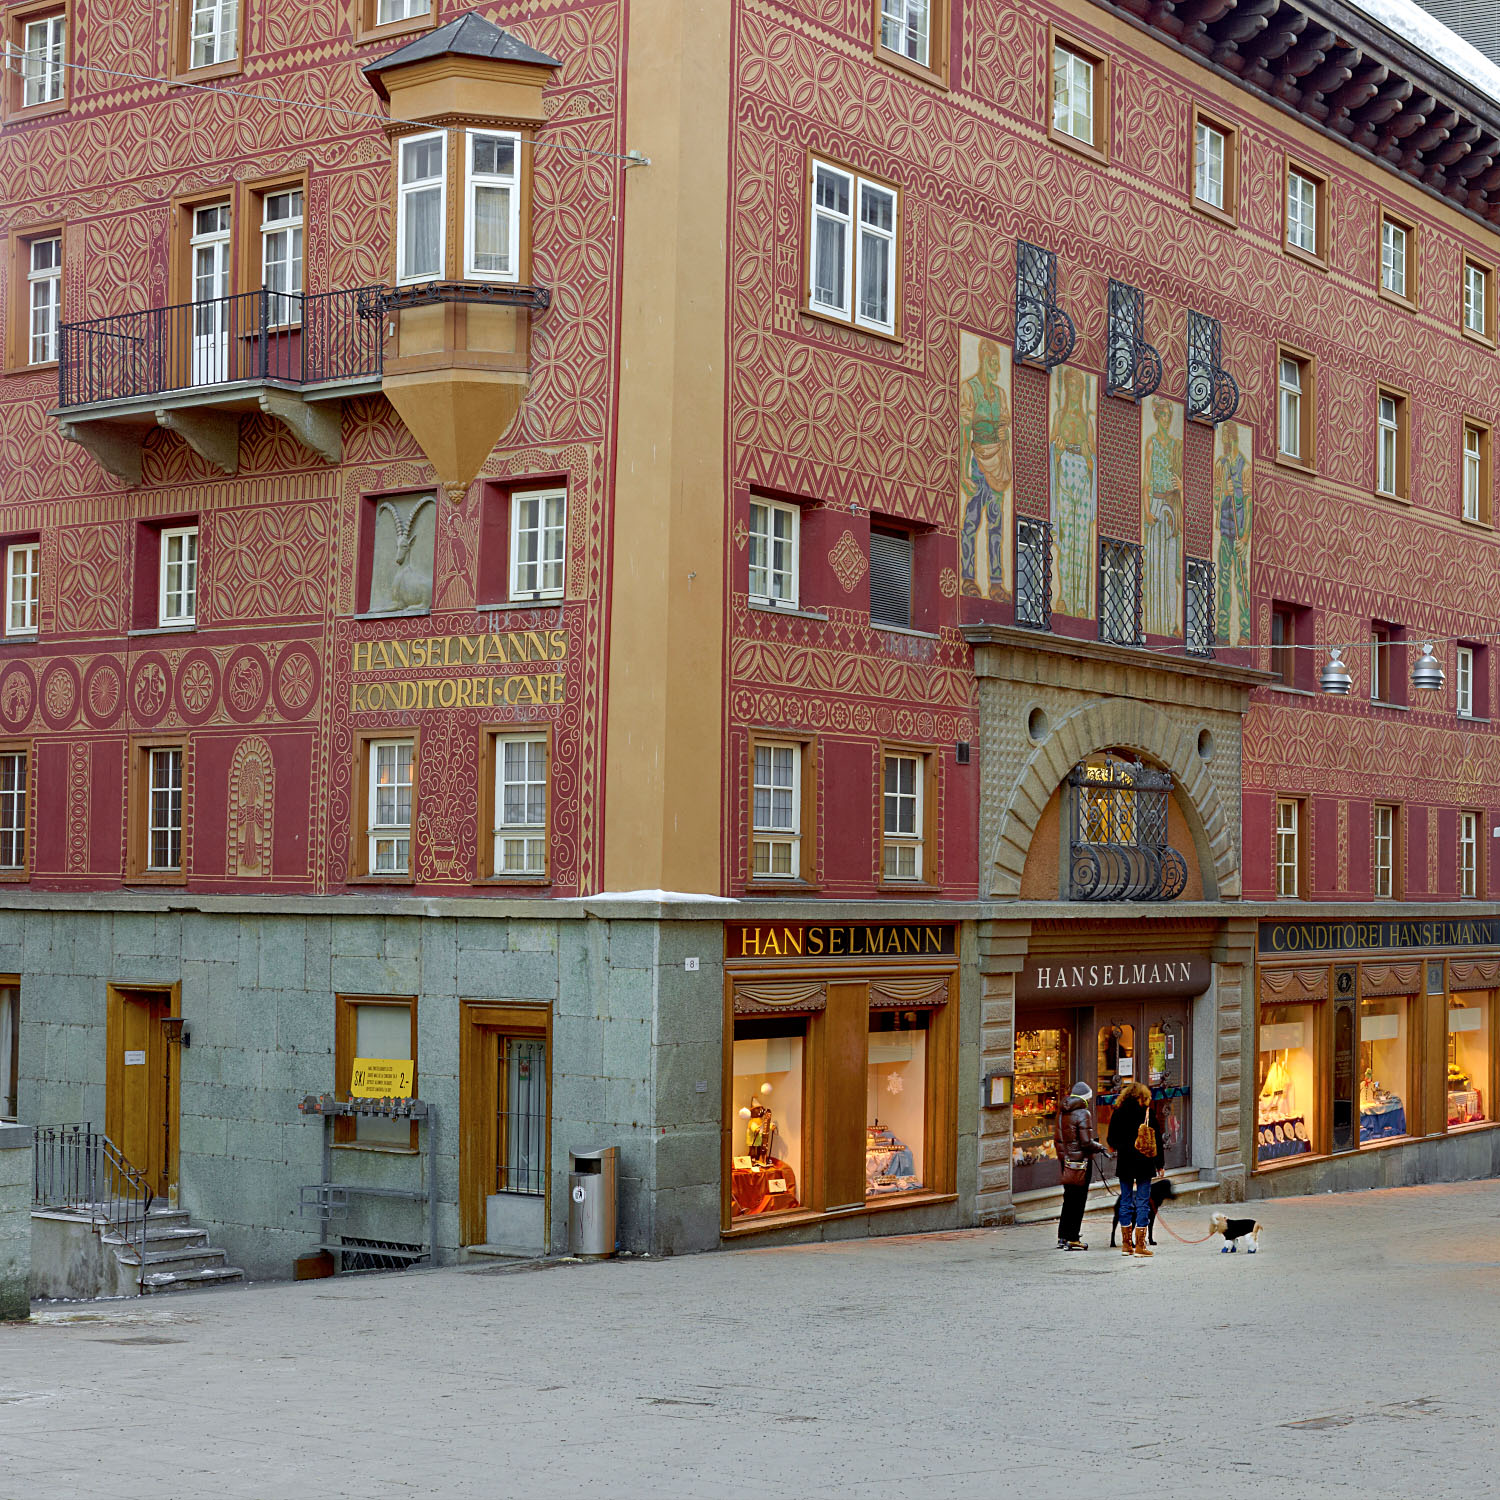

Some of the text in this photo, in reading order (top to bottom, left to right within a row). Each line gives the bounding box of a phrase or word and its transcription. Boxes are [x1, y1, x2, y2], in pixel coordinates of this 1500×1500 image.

[353, 630, 566, 671] HANSELMANNS
[741, 927, 942, 955] HANSELMANN
[1272, 923, 1493, 950] CONDITOREI HANSELMANN
[1037, 962, 1191, 989] HANSELMANN
[354, 1070, 366, 1086] SKI
